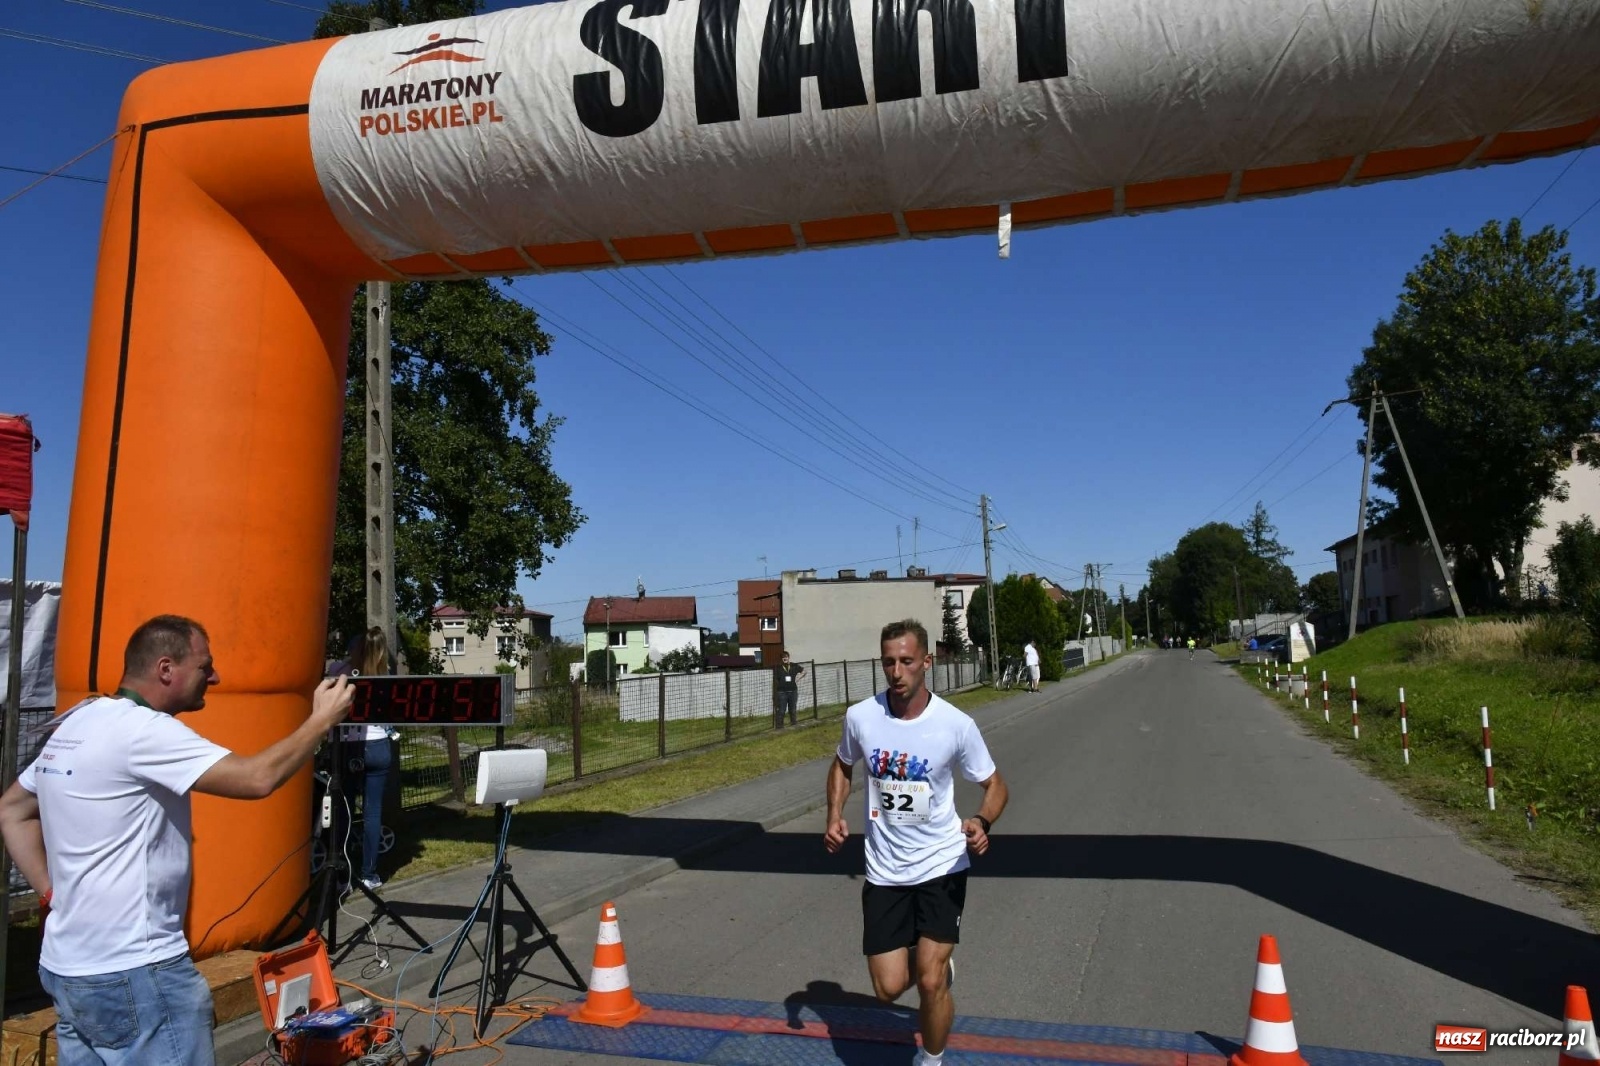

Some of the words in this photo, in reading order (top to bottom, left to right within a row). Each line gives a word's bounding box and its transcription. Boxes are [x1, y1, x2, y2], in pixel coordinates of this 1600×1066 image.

[360, 72, 502, 110] MARATONY
[360, 101, 503, 137] POLSKIE.PL
[872, 780, 903, 793] COLOUR
[907, 784, 925, 794] RUN
[880, 792, 914, 812] 32
